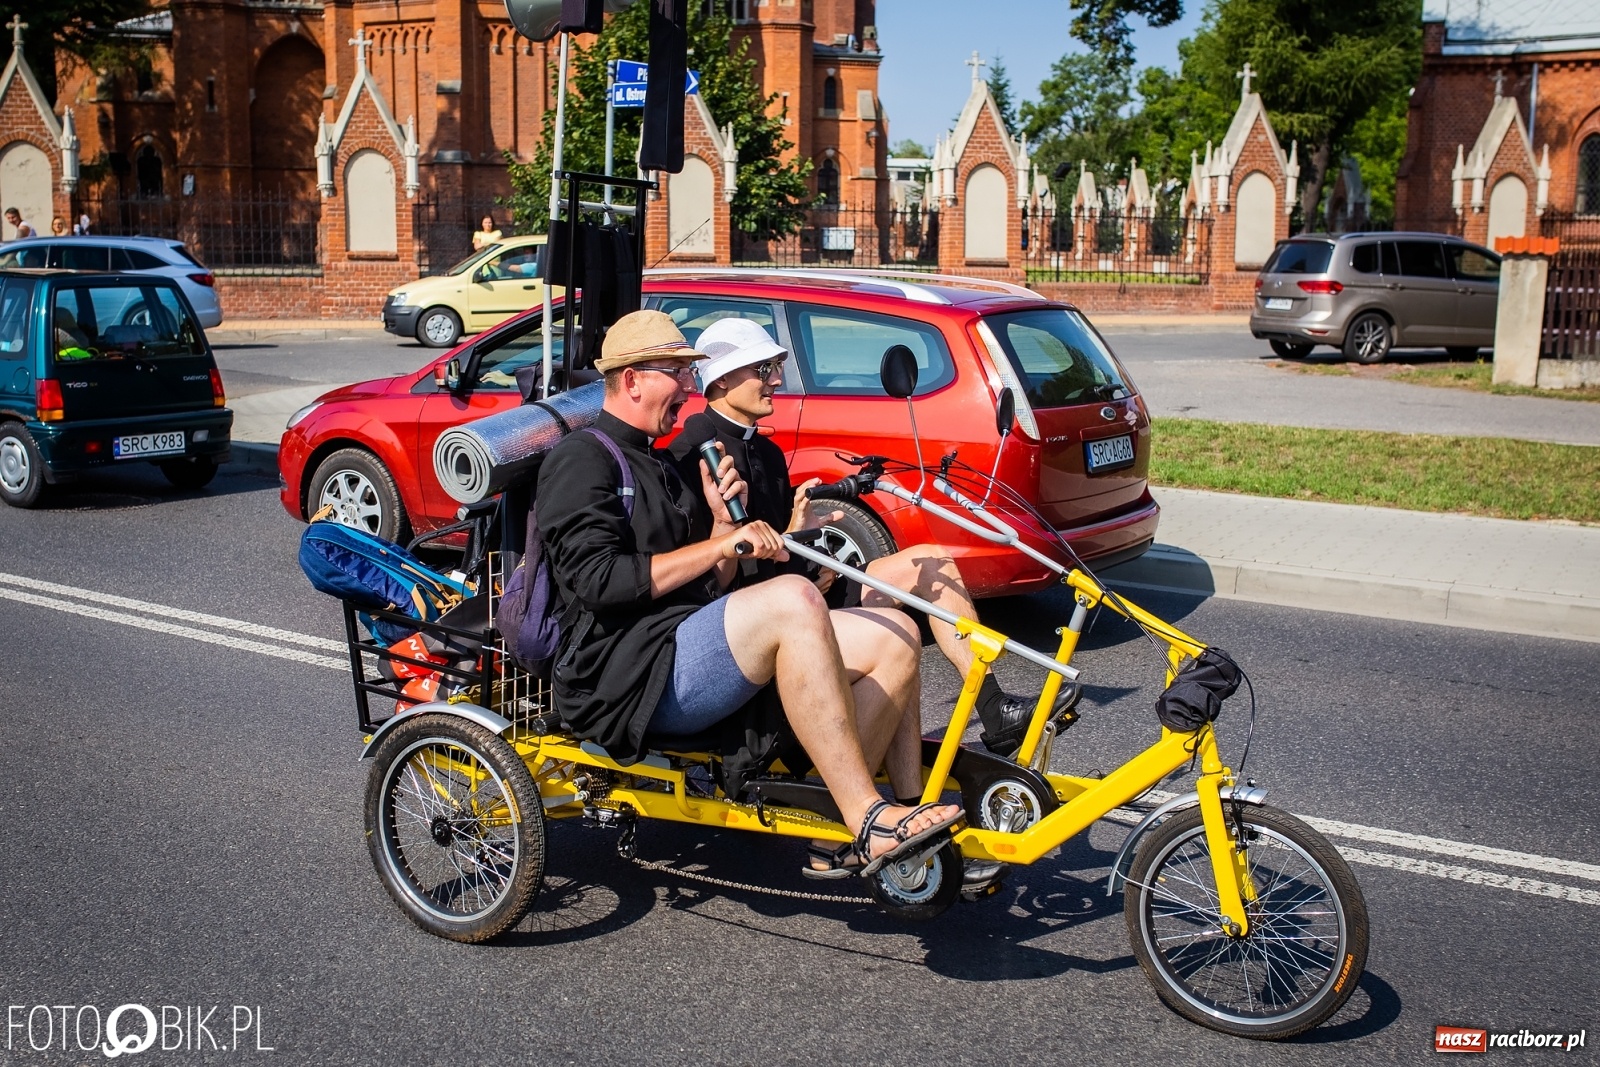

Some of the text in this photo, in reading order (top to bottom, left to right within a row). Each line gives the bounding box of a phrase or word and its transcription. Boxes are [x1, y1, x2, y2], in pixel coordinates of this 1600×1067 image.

[615, 88, 625, 102] ul.
[182, 374, 209, 382] DAEWOO
[121, 433, 184, 454] SRC K983
[1092, 438, 1132, 465] SRC AG68
